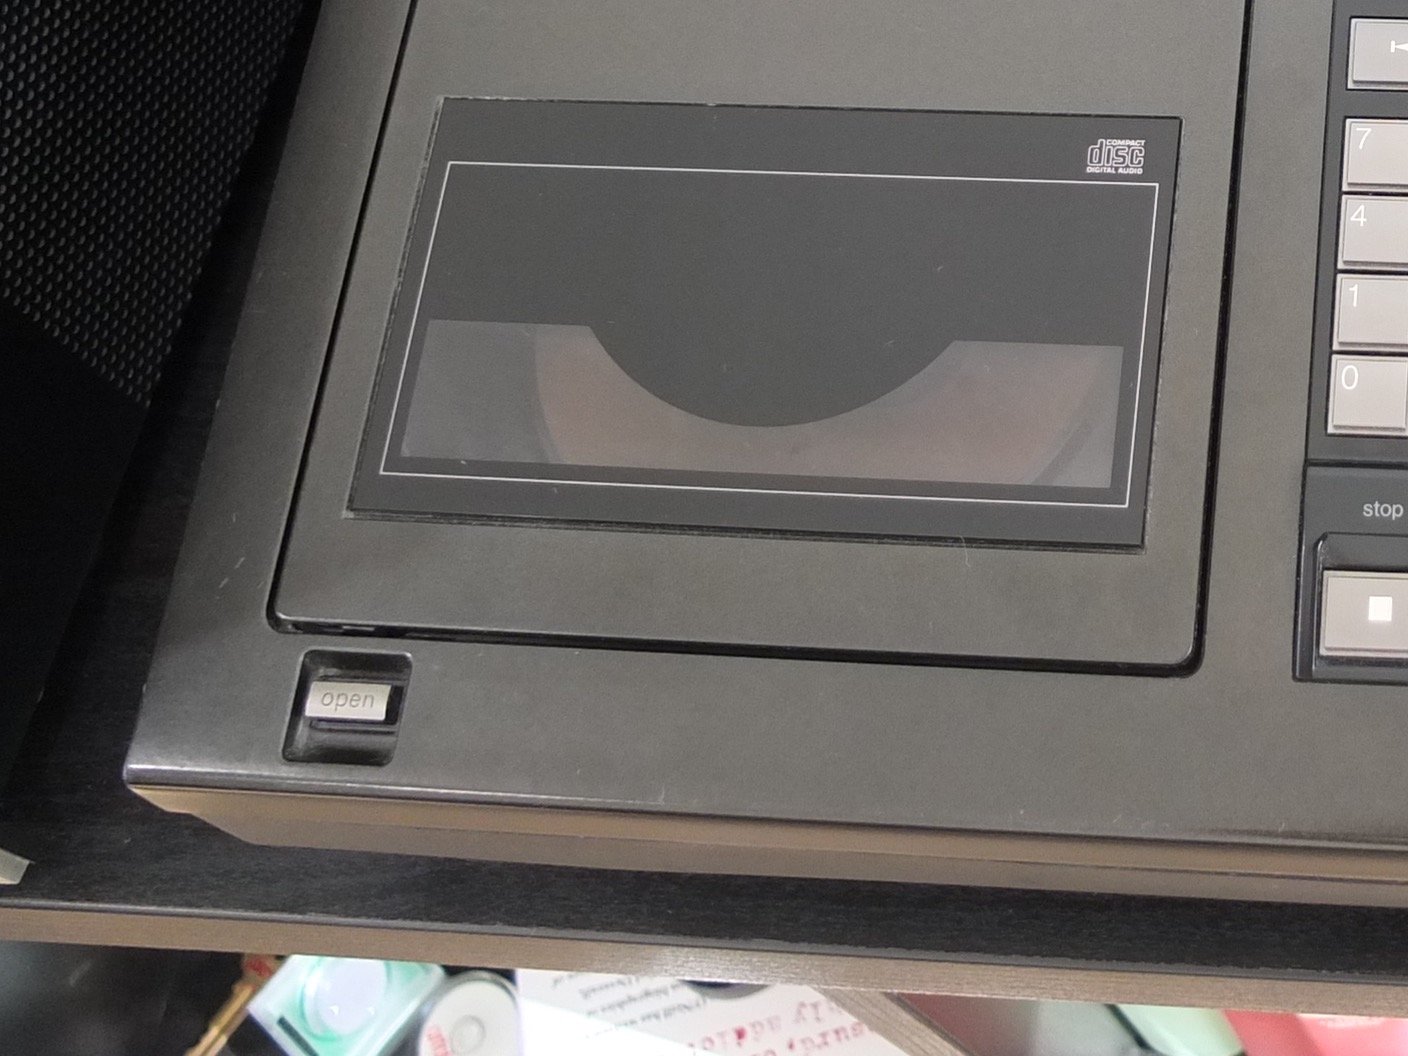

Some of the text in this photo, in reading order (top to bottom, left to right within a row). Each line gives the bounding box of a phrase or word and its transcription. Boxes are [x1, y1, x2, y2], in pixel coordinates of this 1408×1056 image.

[1355, 128, 1372, 150] 7
[1087, 139, 1144, 167] disc
[1086, 166, 1116, 174] DIGITAL
[1351, 205, 1367, 227] 4
[1349, 284, 1358, 307] 1
[1341, 365, 1359, 390] 0
[1363, 501, 1404, 520] stop
[321, 692, 374, 712] open
